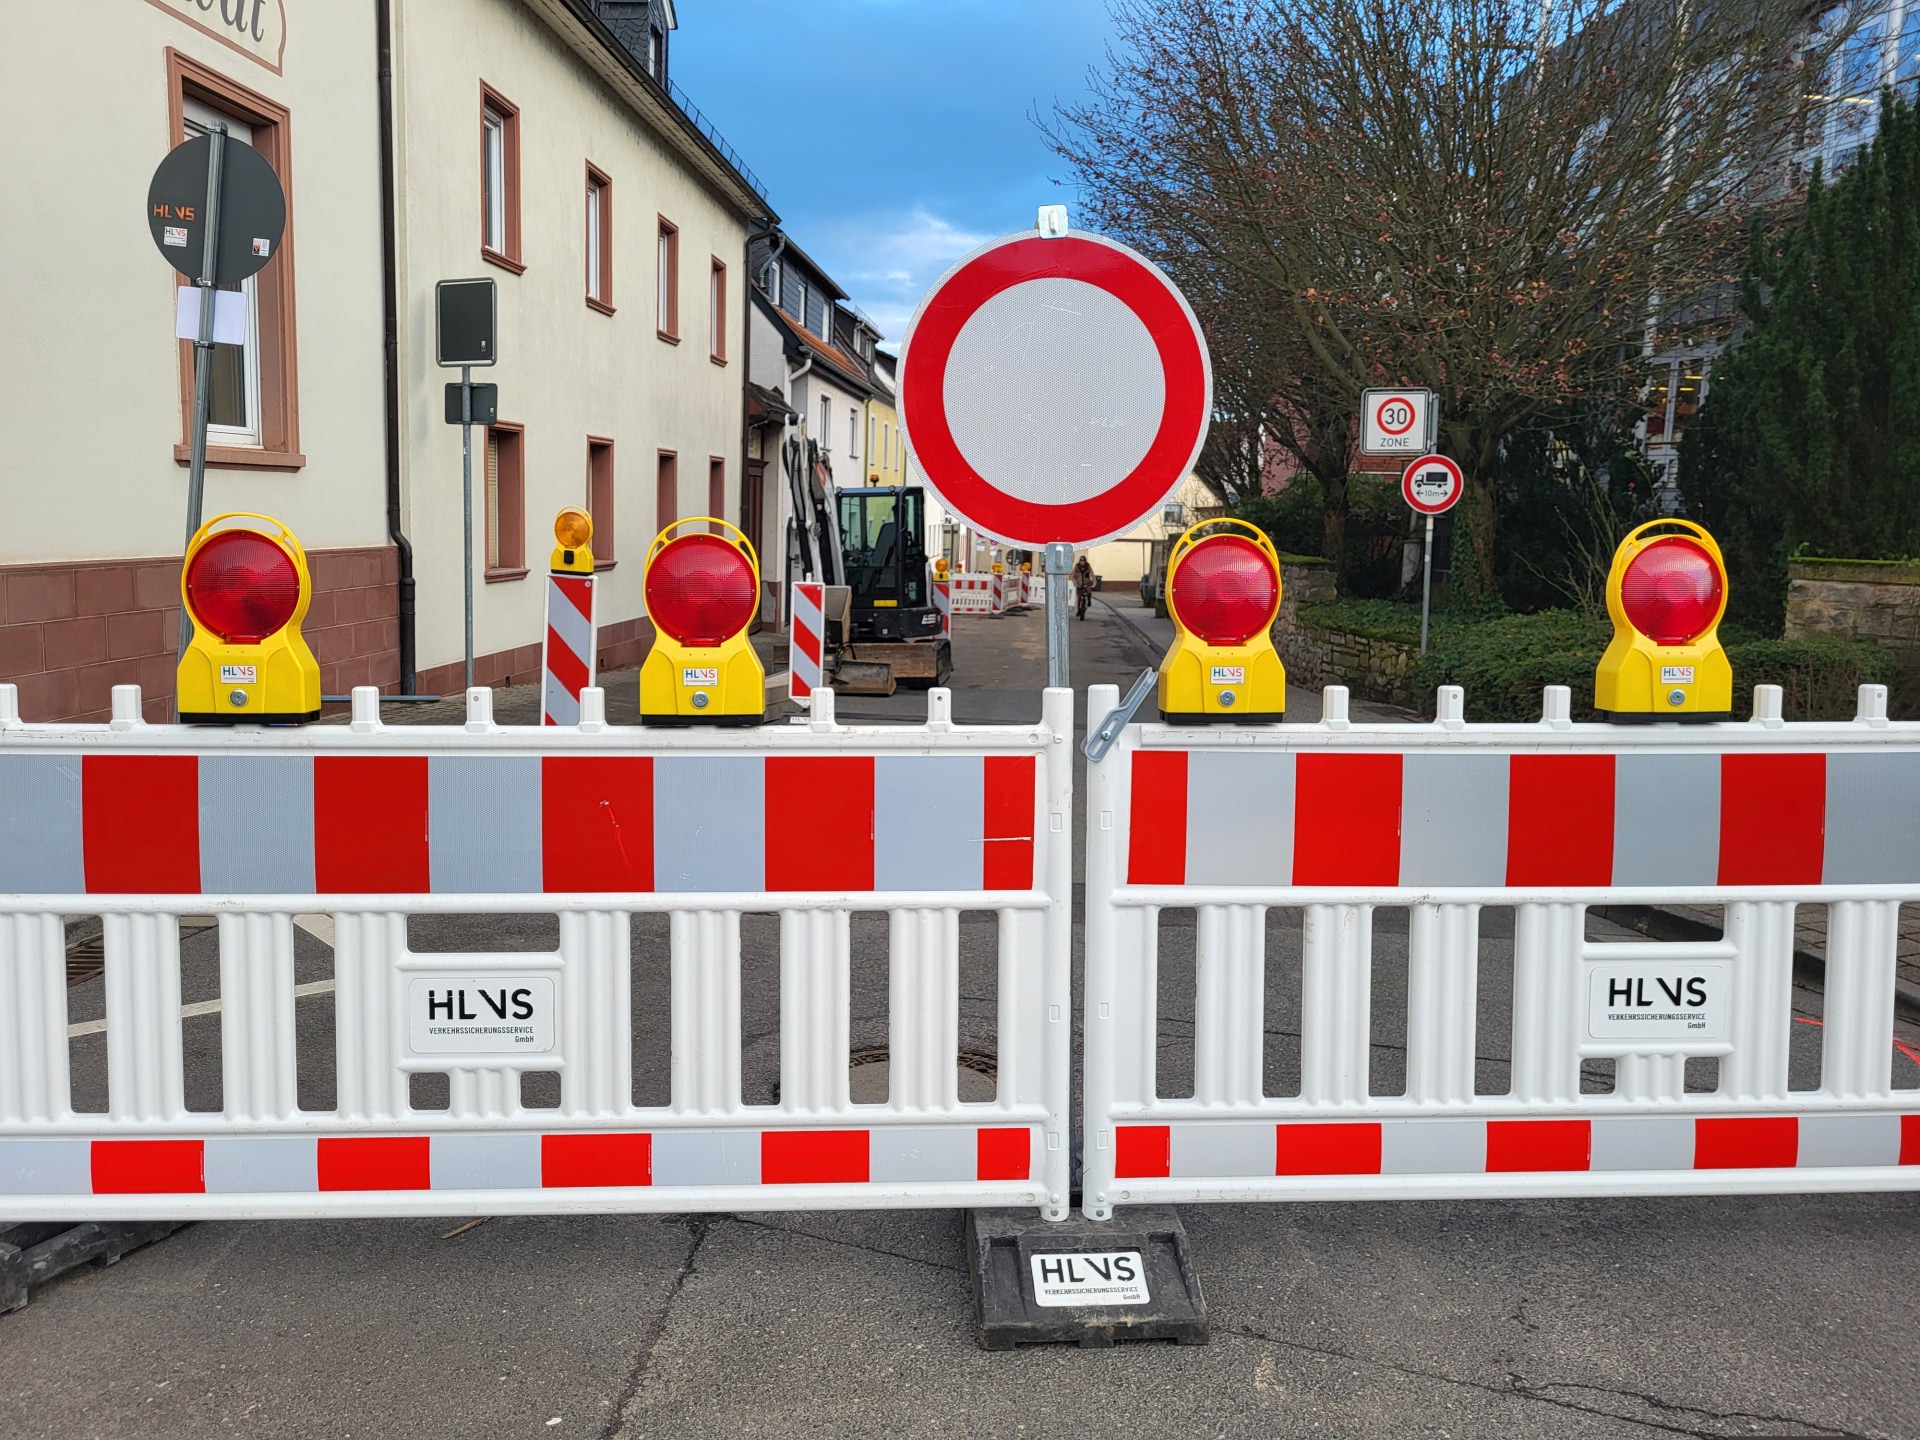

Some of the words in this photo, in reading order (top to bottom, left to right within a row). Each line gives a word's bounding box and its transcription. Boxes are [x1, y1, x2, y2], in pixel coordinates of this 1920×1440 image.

[1385, 408, 1407, 425] 30
[1380, 438, 1410, 447] ZONE
[223, 667, 254, 676] HLVS
[685, 669, 716, 678] HLVS
[1213, 668, 1242, 677] HLVS
[1663, 667, 1692, 676] HLVS
[1608, 977, 1707, 1007] HLVS
[428, 988, 534, 1020] HLVS
[1608, 1013, 1706, 1021] VERKEHRSSICHERUNGSSERVICE
[429, 1026, 534, 1034] VERKEHRSSICHERUNGSSERVICE
[515, 1035, 534, 1043] GmbH
[1040, 1256, 1136, 1283] HLVS
